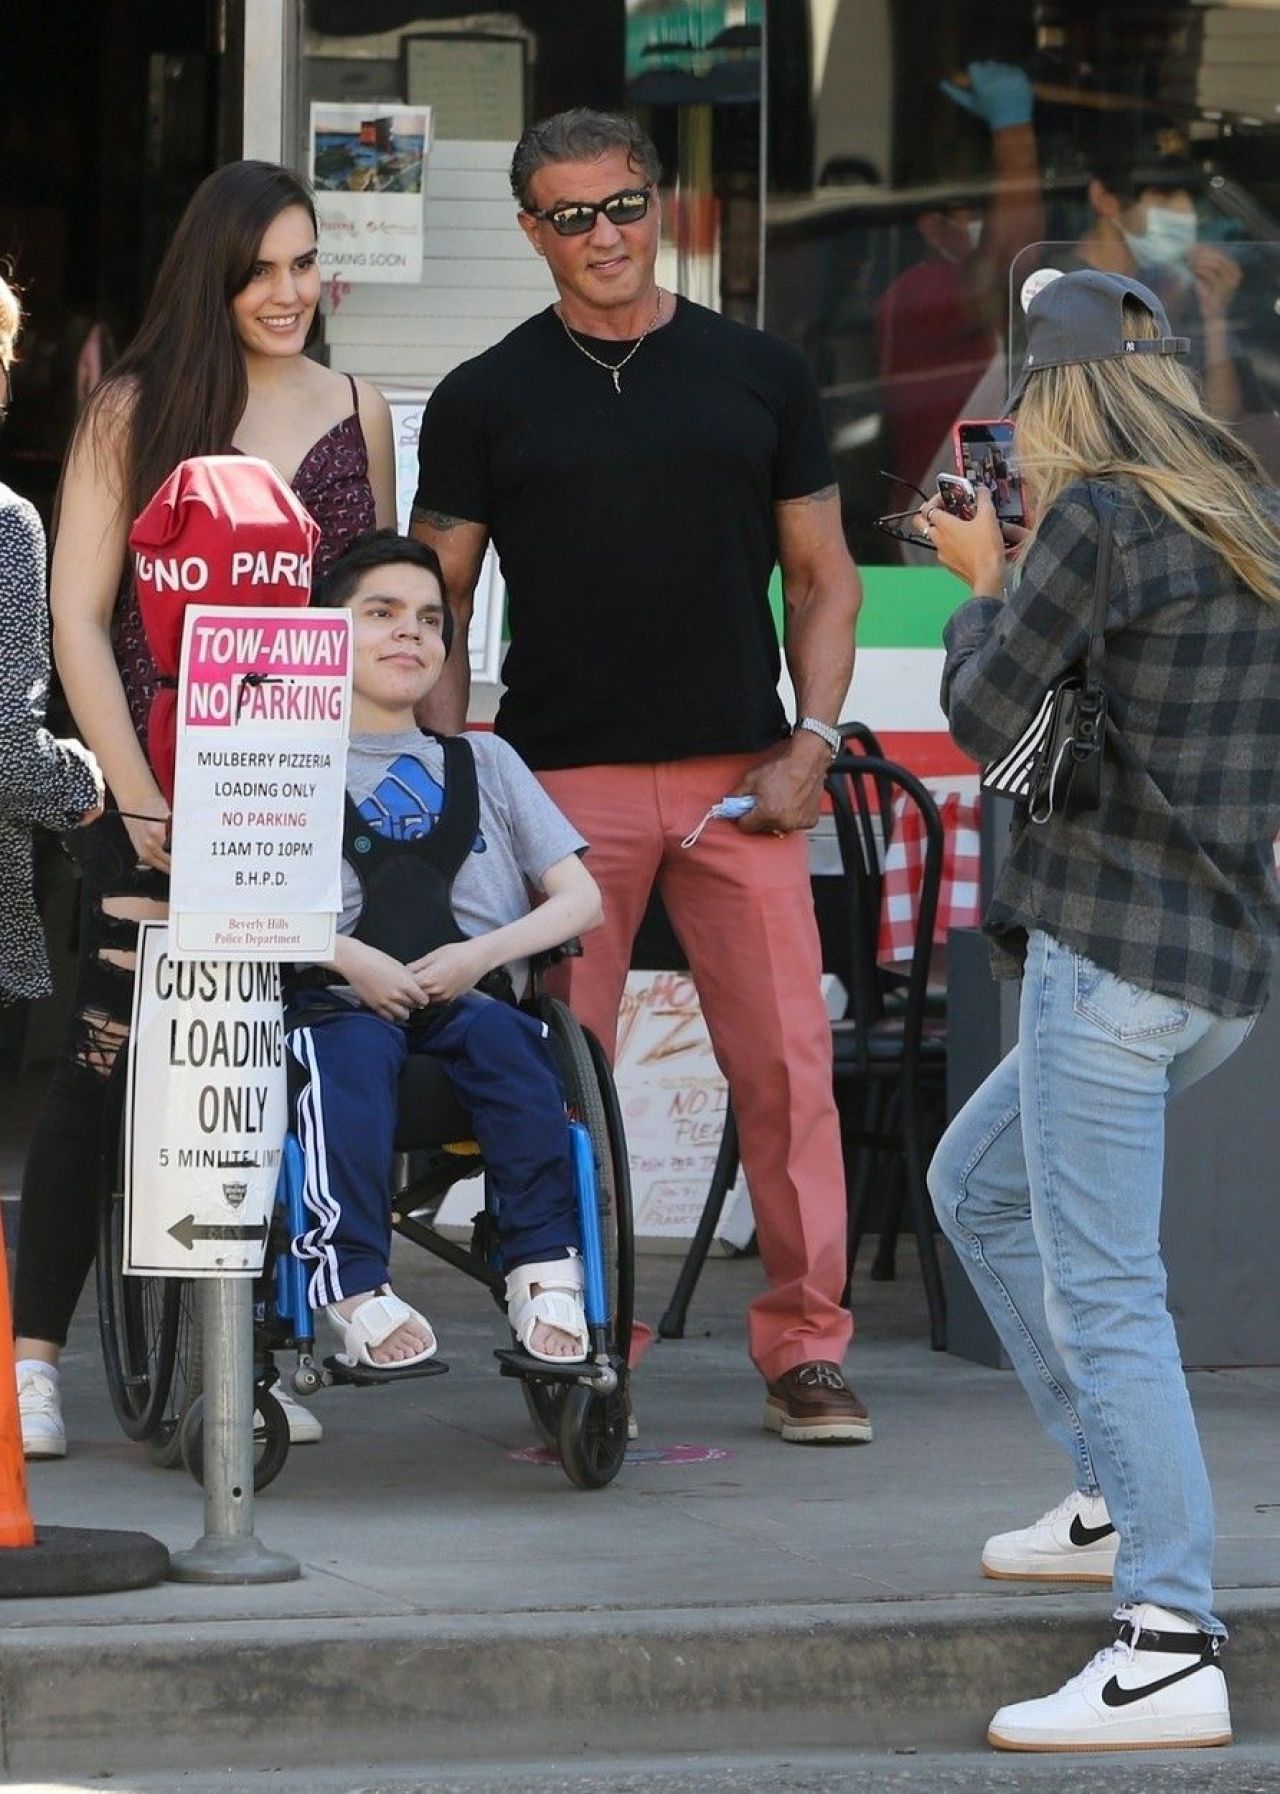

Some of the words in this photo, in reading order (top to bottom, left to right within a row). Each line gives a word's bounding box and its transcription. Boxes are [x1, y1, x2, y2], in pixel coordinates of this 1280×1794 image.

[319, 253, 367, 266] COMING
[369, 253, 407, 267] SOON
[155, 556, 209, 592] NO
[195, 627, 346, 667] TOW-AWAY
[189, 682, 230, 720] NO
[238, 684, 342, 721] PARKING
[197, 752, 275, 768] MULBERRY
[278, 753, 332, 769] PIZZERIA
[214, 782, 278, 798] LOADING
[282, 783, 316, 799] ONLY
[222, 812, 244, 827] NO
[247, 812, 307, 827] PARKING
[211, 841, 252, 857] 11AM
[256, 842, 274, 857] TO
[277, 842, 313, 857] 10PM
[235, 871, 288, 886] B.H.P.D.
[229, 918, 264, 931] Beverly
[267, 918, 289, 929] Hills
[214, 932, 242, 944] Police
[245, 932, 301, 946] Department
[170, 1018, 283, 1068] LOADING
[198, 1085, 268, 1134] ONLY
[159, 1148, 169, 1168] 5
[178, 1149, 250, 1168] MINUTE
